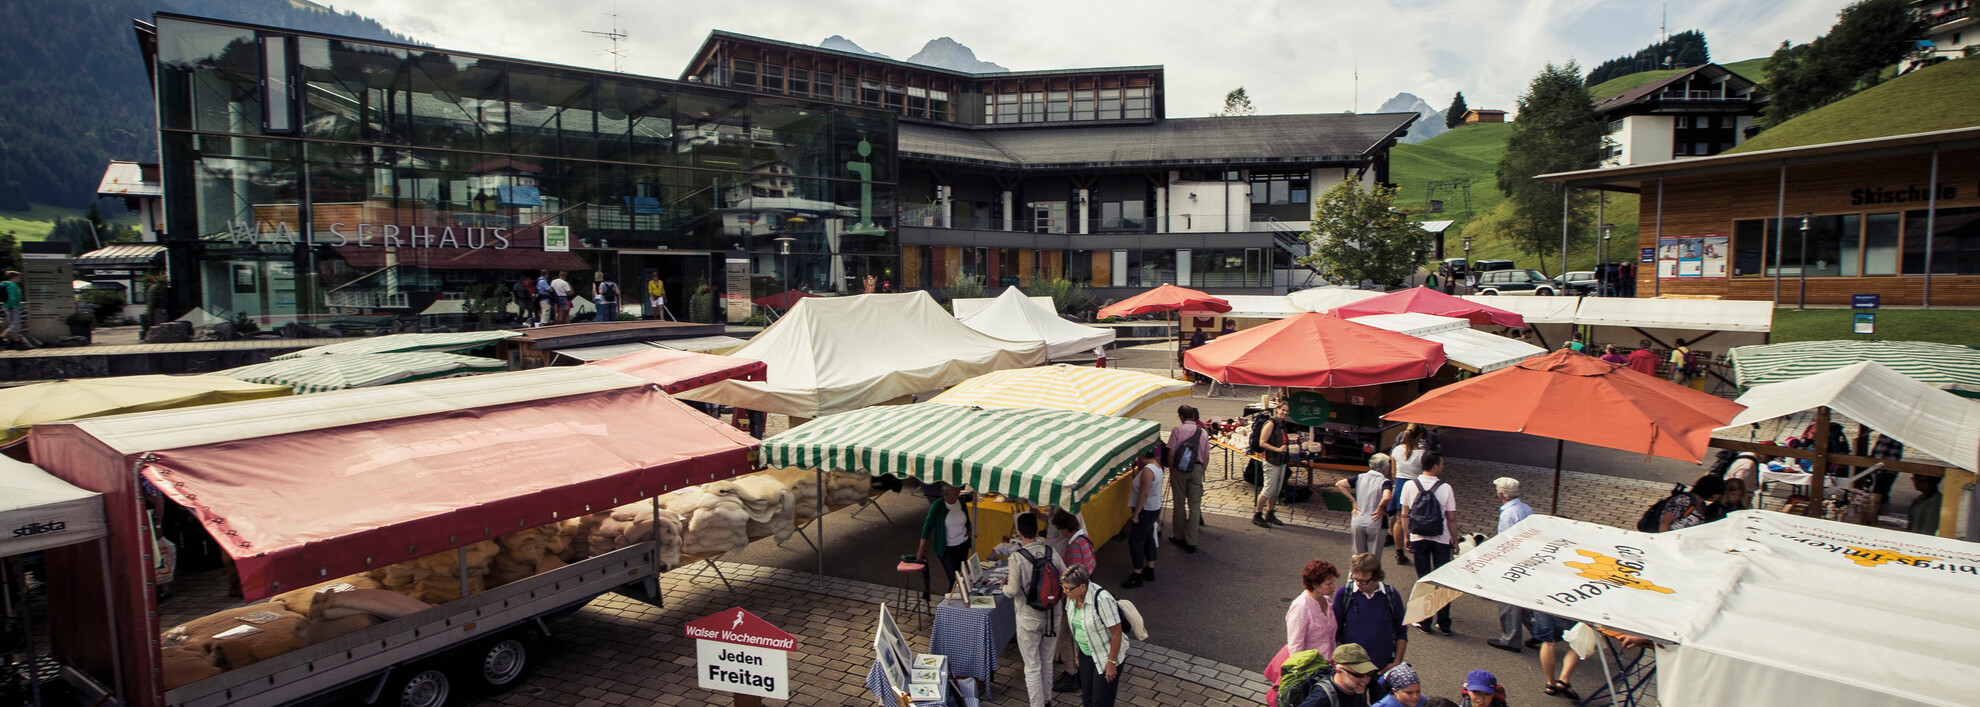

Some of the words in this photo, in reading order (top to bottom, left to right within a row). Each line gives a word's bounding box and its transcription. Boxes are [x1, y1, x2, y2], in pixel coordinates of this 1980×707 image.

[1851, 182, 1957, 205] Skischule
[226, 219, 510, 249] WALSERHAUS
[12, 520, 66, 538] stilista
[686, 625, 719, 639] Walser
[722, 630, 794, 649] Wochenmarkt
[718, 649, 762, 666] Jeden
[709, 664, 774, 692] Freitag
